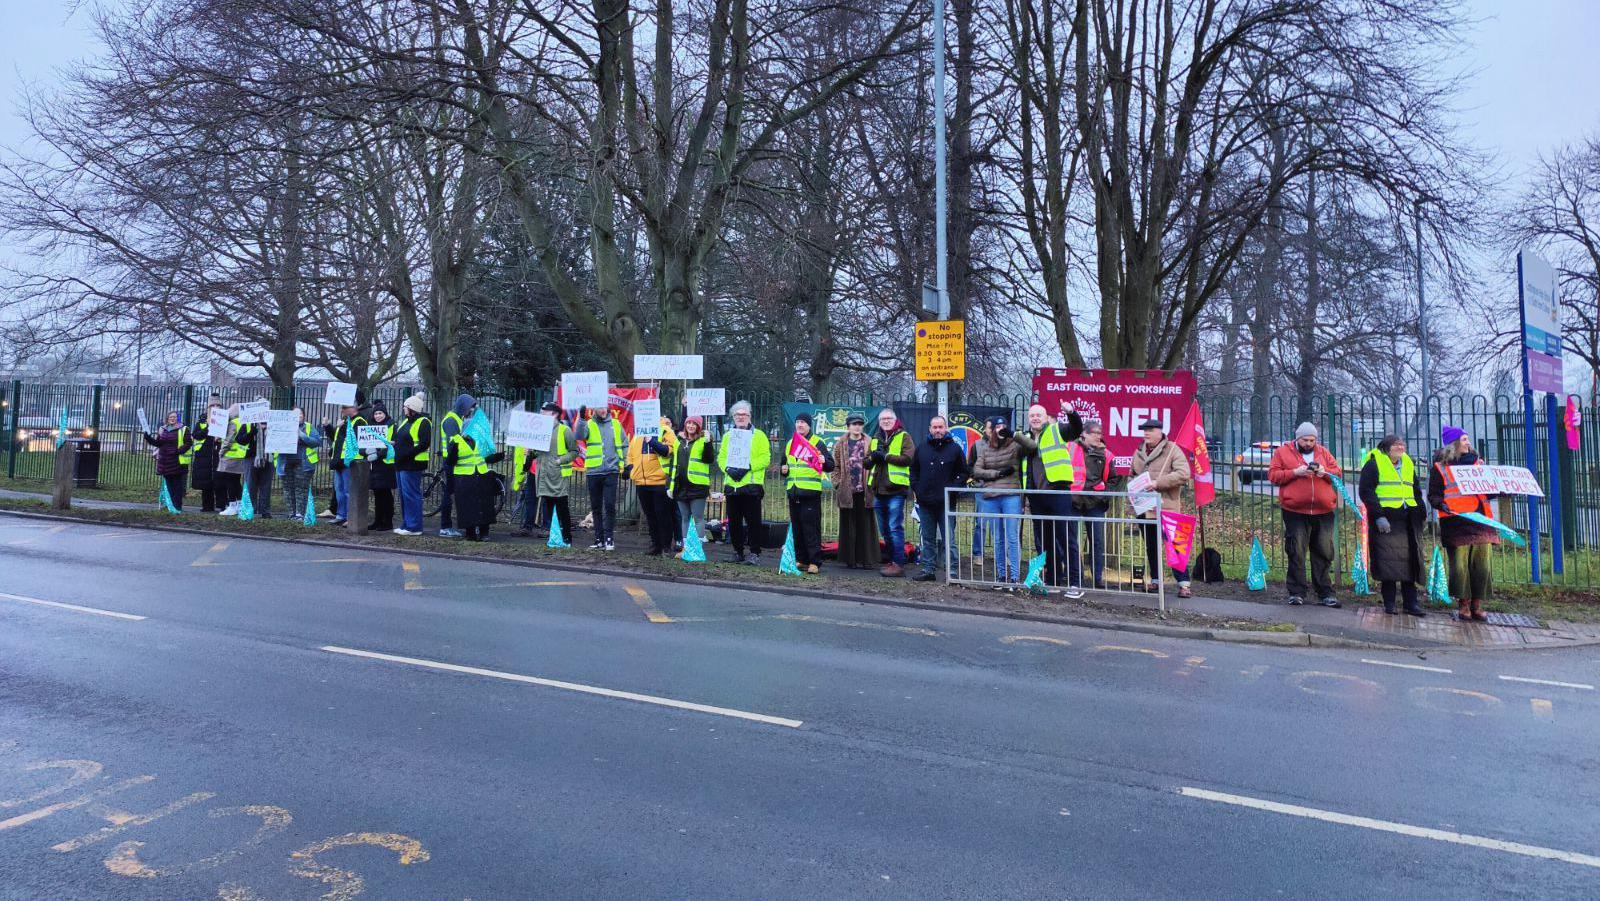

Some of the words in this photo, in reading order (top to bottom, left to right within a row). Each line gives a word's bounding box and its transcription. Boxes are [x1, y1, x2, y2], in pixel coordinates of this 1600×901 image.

[1046, 383, 1071, 391] EAST
[1073, 383, 1106, 393] RIDING
[1108, 384, 1122, 393] OF
[1125, 385, 1182, 395] YORKSHIRE
[1109, 406, 1171, 438] NEU
[636, 426, 659, 435] FAILURE
[1456, 468, 1484, 478] STOP
[1491, 468, 1511, 478] THE
[1460, 479, 1499, 492] FOLLOW
[1502, 479, 1540, 494] POLICY
[1172, 521, 1193, 556] PAY
